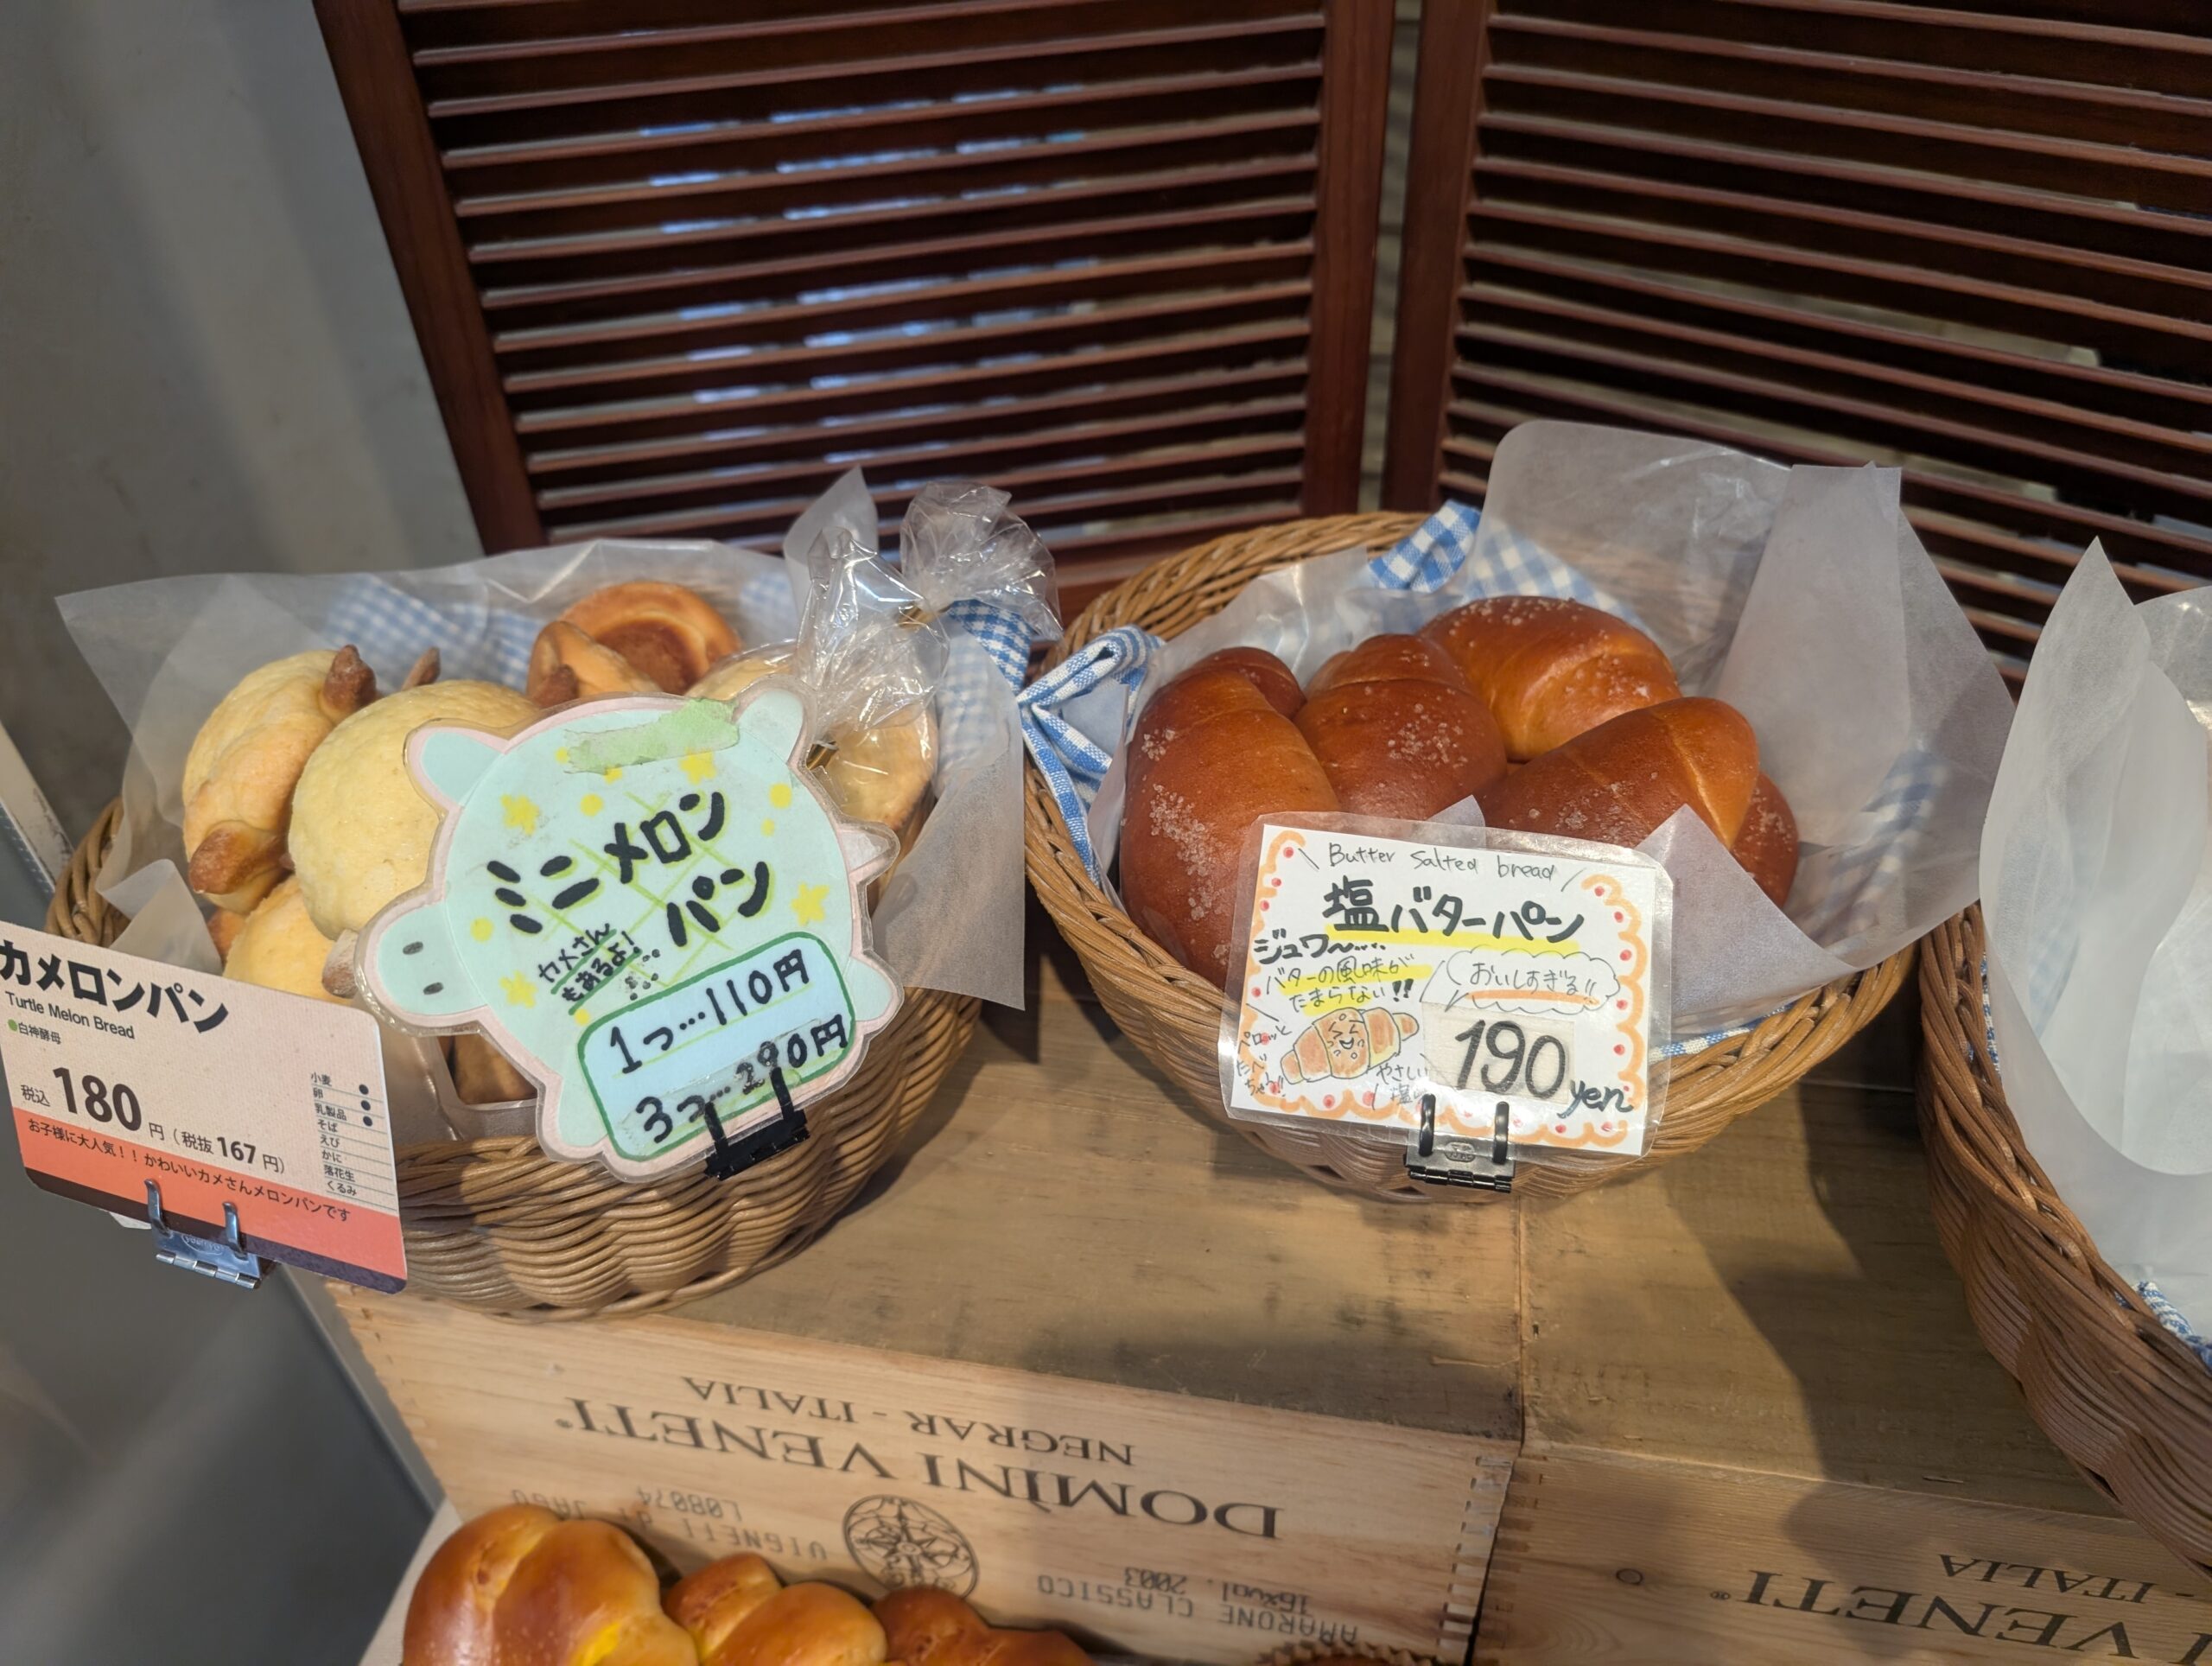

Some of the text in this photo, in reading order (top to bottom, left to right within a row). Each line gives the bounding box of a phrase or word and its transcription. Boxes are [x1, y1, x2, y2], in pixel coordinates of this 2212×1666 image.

[486, 792, 725, 934] ミニメロン
[1329, 843, 1554, 880] Butter Salted bread
[666, 861, 770, 947] パン
[1322, 874, 1585, 943] 塩バターパン
[538, 923, 610, 982] カメさん
[0, 939, 229, 1033] カメロンパン
[1267, 954, 1414, 995] バターの風味が
[5, 991, 135, 1039] Turtle Melon Bread
[18, 1021, 61, 1045] 白神酵母
[311, 1071, 332, 1086] 小麦
[1376, 1063, 1427, 1085] やさしい
[1455, 1019, 1566, 1099] 190
[313, 1087, 323, 1099] 卵
[315, 1103, 346, 1121] 乳製品
[1557, 1079, 1634, 1119] yen
[21, 1084, 50, 1107] 税込
[53, 1066, 142, 1131] 180
[217, 1137, 257, 1164] 167
[318, 1119, 338, 1133] そば
[321, 1135, 340, 1148] えび
[322, 1150, 342, 1163] かに
[324, 1165, 355, 1183] 落花生
[327, 1180, 357, 1196] くるみ
[681, 1376, 859, 1423] ITALIA
[903, 1410, 1136, 1466] NEGRAR
[1124, 1566, 1188, 1595] 2003
[1938, 1554, 2158, 1604] ITALIA
[1037, 1574, 1357, 1643] AMARONE CLASSICO
